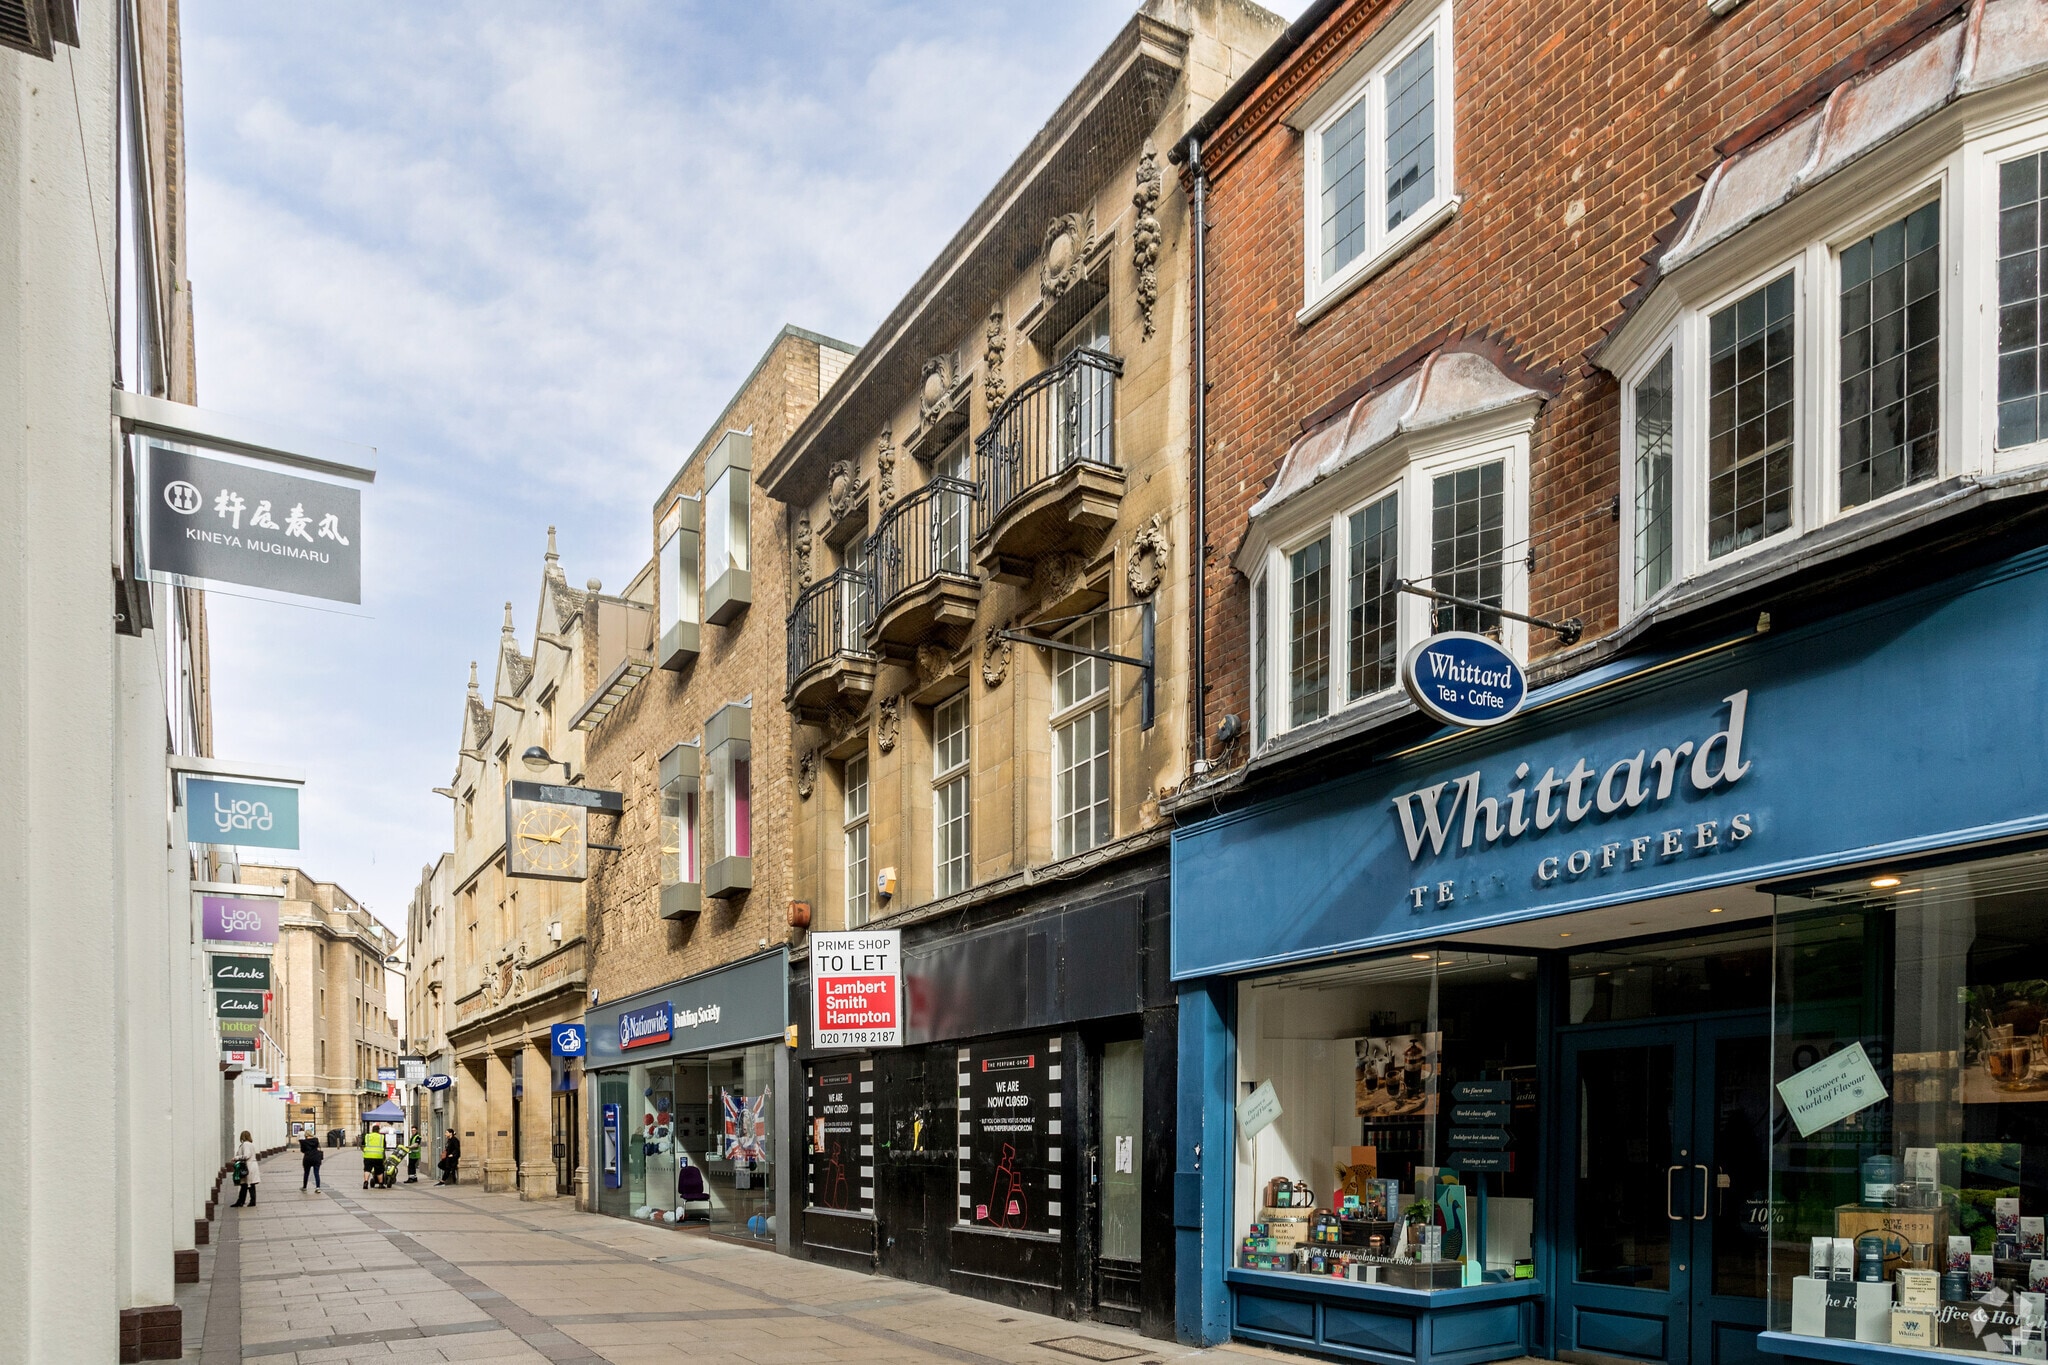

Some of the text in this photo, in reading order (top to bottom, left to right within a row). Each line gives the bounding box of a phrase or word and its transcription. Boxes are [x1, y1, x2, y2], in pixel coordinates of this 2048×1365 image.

[186, 527, 330, 564] KINEYA MUGIMARU
[1427, 650, 1512, 690] Whittard
[1437, 684, 1504, 709] Tea Coffee
[1391, 688, 1753, 862] Whittard
[214, 812, 273, 833] yard
[1537, 812, 1754, 882] COFFEES
[221, 918, 261, 933] yard
[817, 939, 891, 951] PRIME SHOP
[818, 954, 888, 972] TO LET
[217, 965, 265, 979] Clarks
[826, 980, 887, 995] Lambert
[220, 999, 259, 1010] Clarks
[826, 995, 867, 1009] Smith
[630, 1009, 668, 1038] Nationwide
[674, 1003, 720, 1029] Building Society
[826, 1011, 891, 1026] Hampton
[222, 1021, 257, 1032] hotter
[820, 1031, 895, 1044] 020 7198 2187
[996, 1080, 1019, 1093] WE ARE
[1797, 1073, 1866, 1114] World of Flavour
[1805, 1074, 1840, 1099] Discover
[987, 1095, 1029, 1108] NOW CLOSED
[1749, 1207, 1784, 1223] 10%
[1340, 1249, 1376, 1263] Chocolate
[1376, 1254, 1396, 1264] since
[1395, 1257, 1414, 1266] 1886
[1973, 1308, 1989, 1323] &
[1991, 1310, 2021, 1325] Hot
